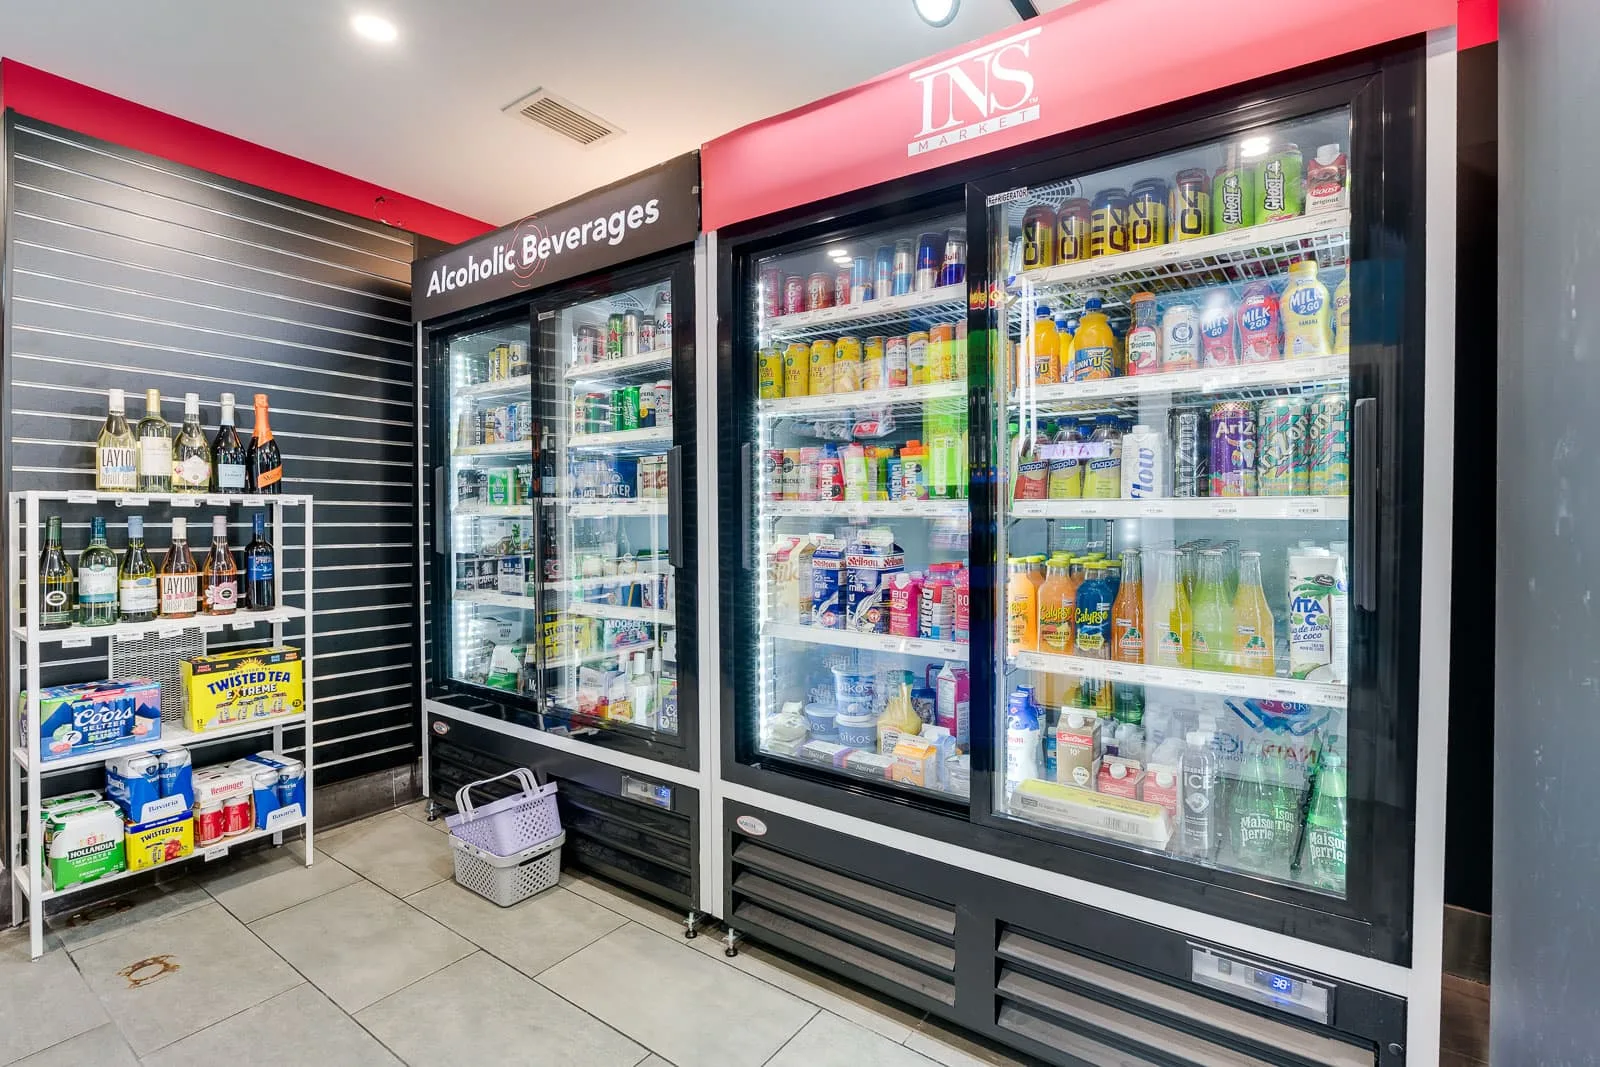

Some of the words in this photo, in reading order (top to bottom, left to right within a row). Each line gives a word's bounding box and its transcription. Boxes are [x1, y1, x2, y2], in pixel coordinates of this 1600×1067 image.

[914, 39, 1034, 138] INS
[918, 110, 1027, 153] MARKET
[426, 244, 516, 298] Alcoholic
[522, 198, 660, 266] Beverages
[1290, 288, 1323, 309] MILK
[1300, 301, 1320, 314] 2GO
[1242, 306, 1271, 327] MILK
[1249, 318, 1268, 330] 2GO
[1291, 596, 1325, 614] VITA
[207, 671, 266, 695] TWISTED
[269, 671, 291, 683] TEA
[226, 684, 278, 702] EXTREME
[74, 706, 133, 727] Coors
[83, 719, 127, 732] SELTZER
[1184, 774, 1213, 790] ICE
[141, 827, 171, 843] TWISTED
[171, 826, 184, 834] TEA
[70, 841, 115, 859] HOLLANDIA
